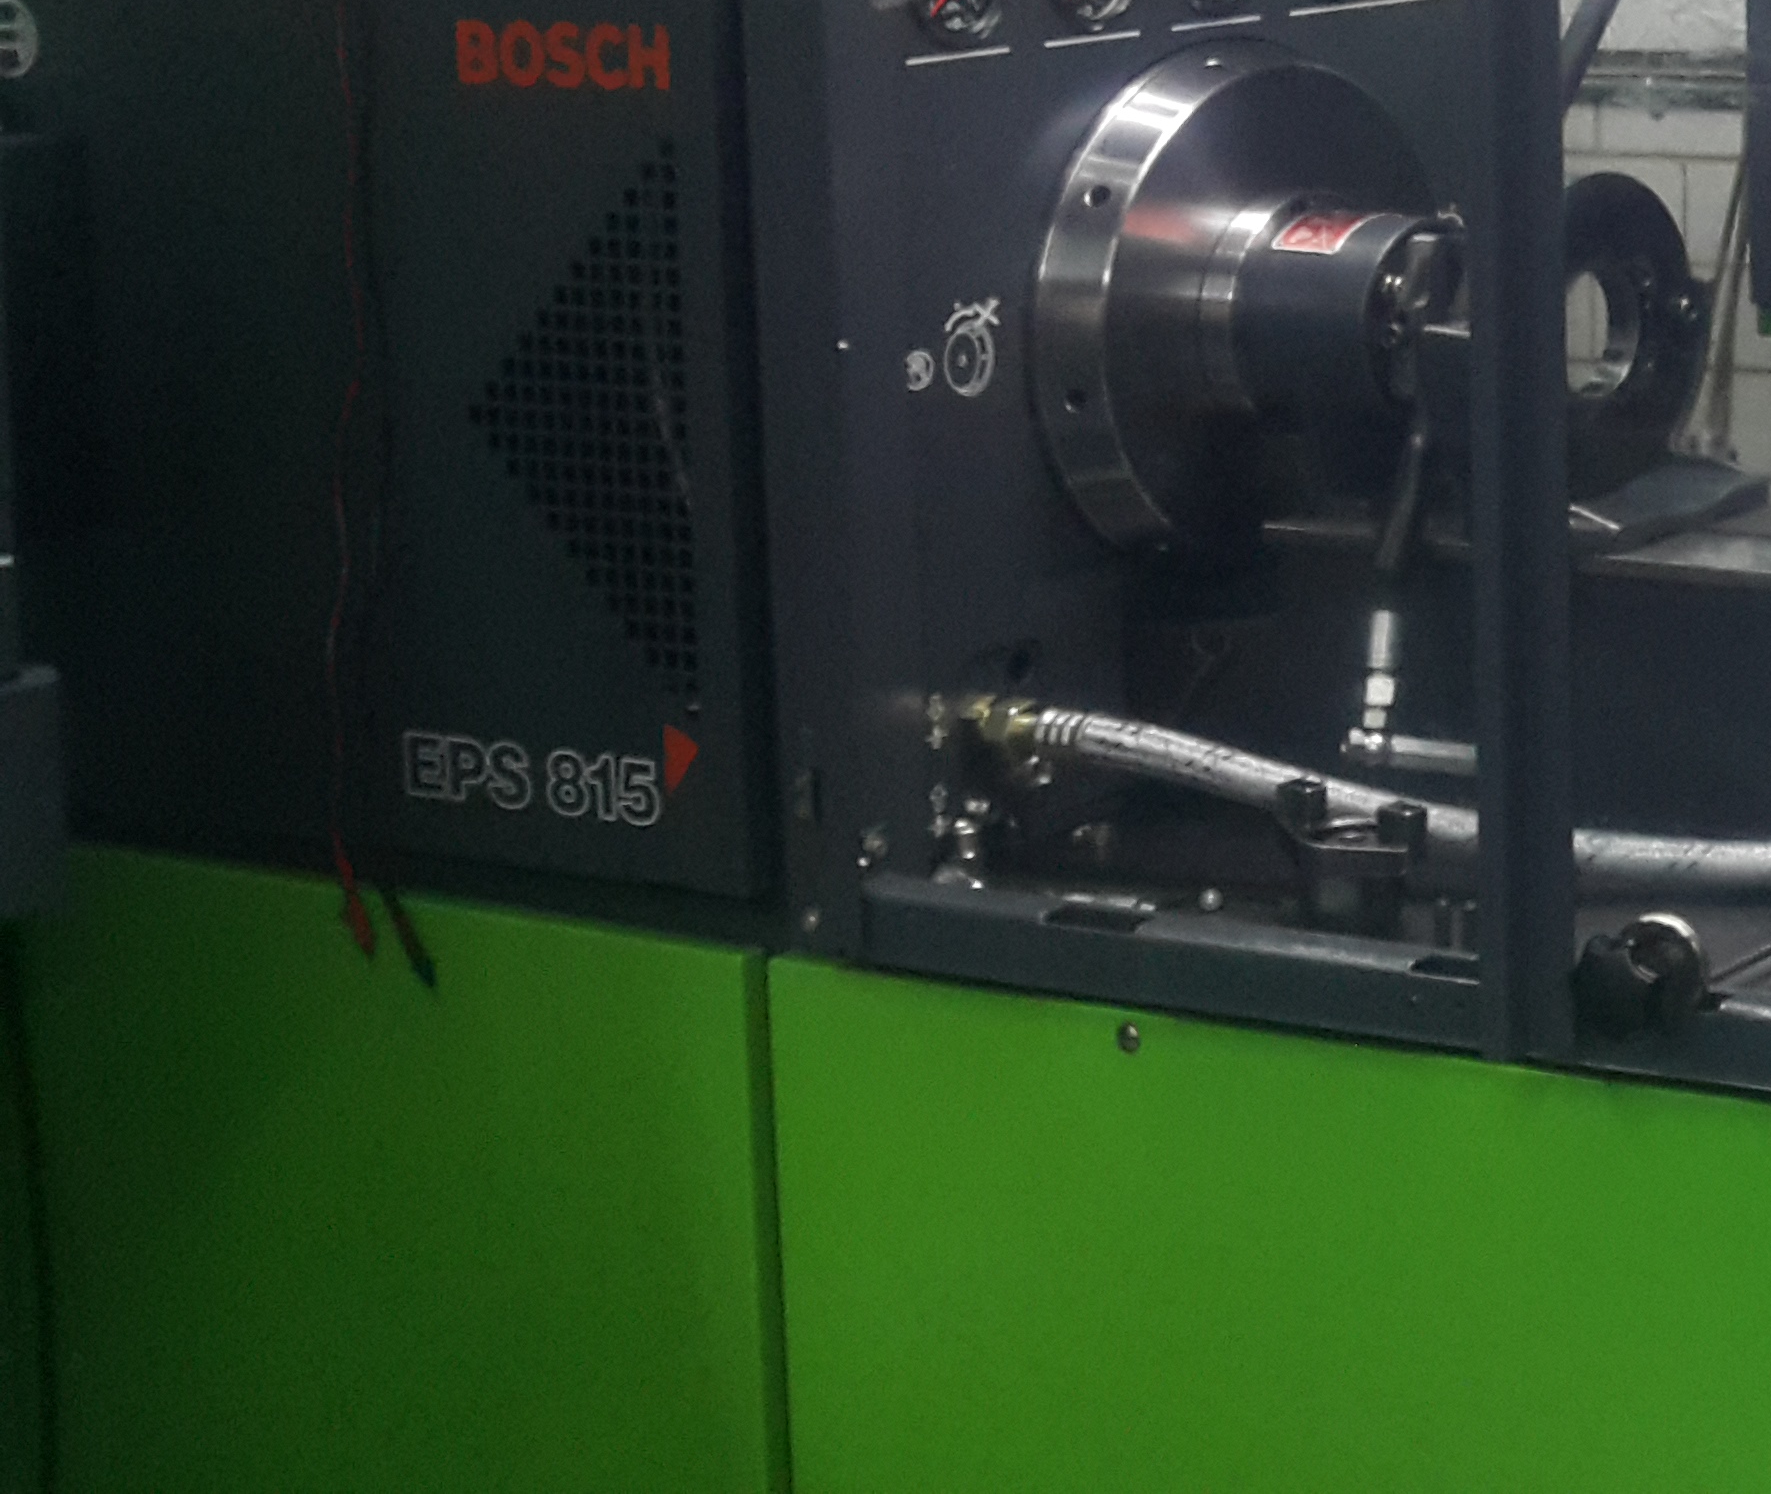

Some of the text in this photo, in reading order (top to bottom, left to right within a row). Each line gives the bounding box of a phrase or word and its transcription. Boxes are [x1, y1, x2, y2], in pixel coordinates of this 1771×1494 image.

[455, 18, 671, 91] BOSCH
[402, 730, 661, 827] EPS 815
